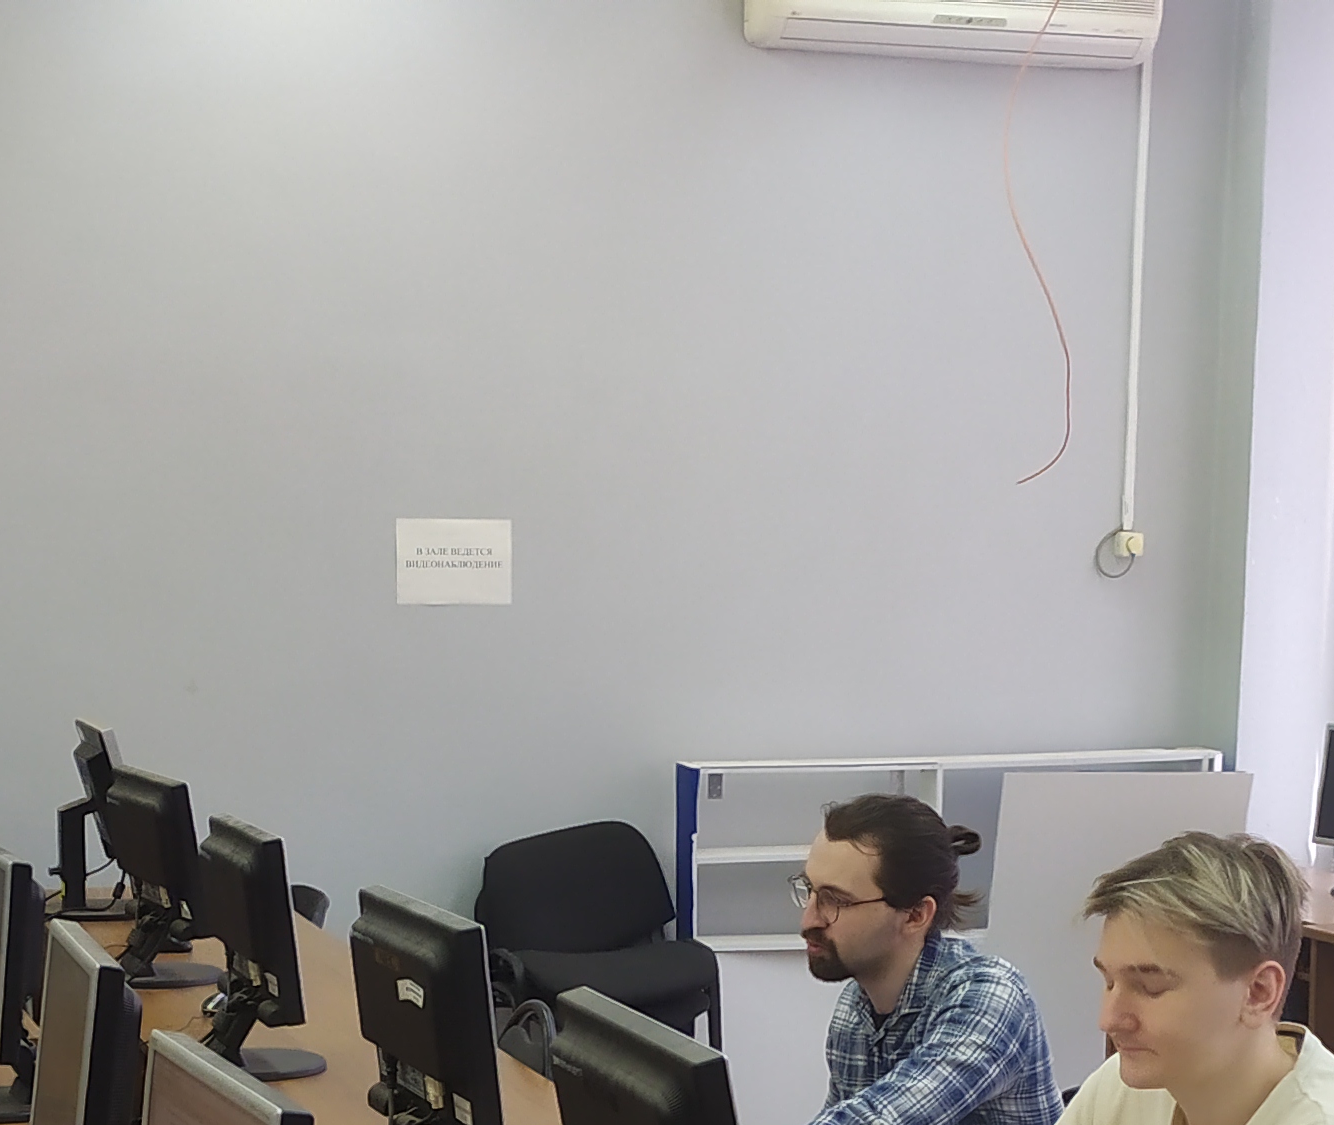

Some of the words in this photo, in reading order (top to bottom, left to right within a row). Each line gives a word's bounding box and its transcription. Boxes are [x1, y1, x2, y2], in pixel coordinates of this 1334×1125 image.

[416, 547, 423, 555] В
[425, 547, 449, 556] ЗАЛЕ
[451, 547, 493, 557] ВЕДЕТСЯ
[405, 559, 503, 570] ВИДЕОНАБЛЮДЕНИЕ
